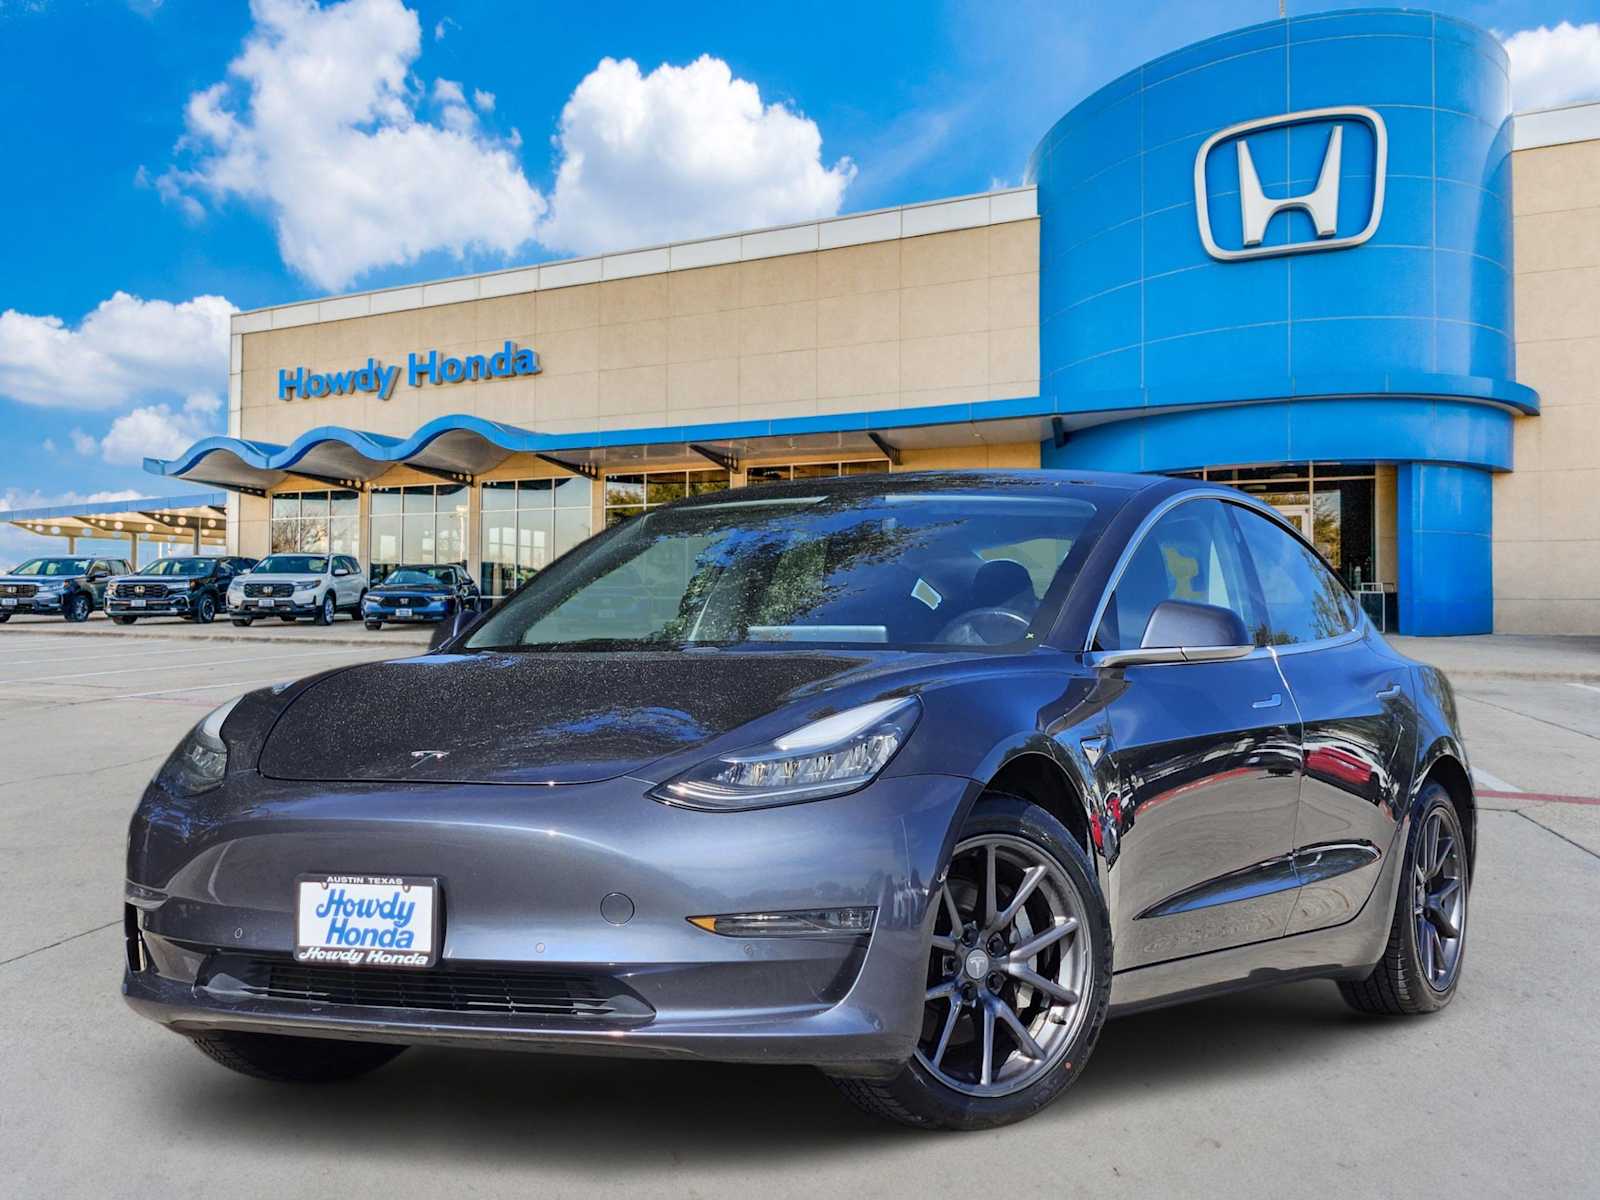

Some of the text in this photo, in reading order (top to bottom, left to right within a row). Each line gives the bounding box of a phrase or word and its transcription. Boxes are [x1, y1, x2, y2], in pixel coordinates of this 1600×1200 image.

[278, 340, 541, 400] Howdy Honda
[327, 876, 403, 886] AUSTIN TEXAS
[316, 889, 416, 928] Howdy
[325, 918, 415, 948] Honda
[299, 947, 428, 965] Howdy Honda
